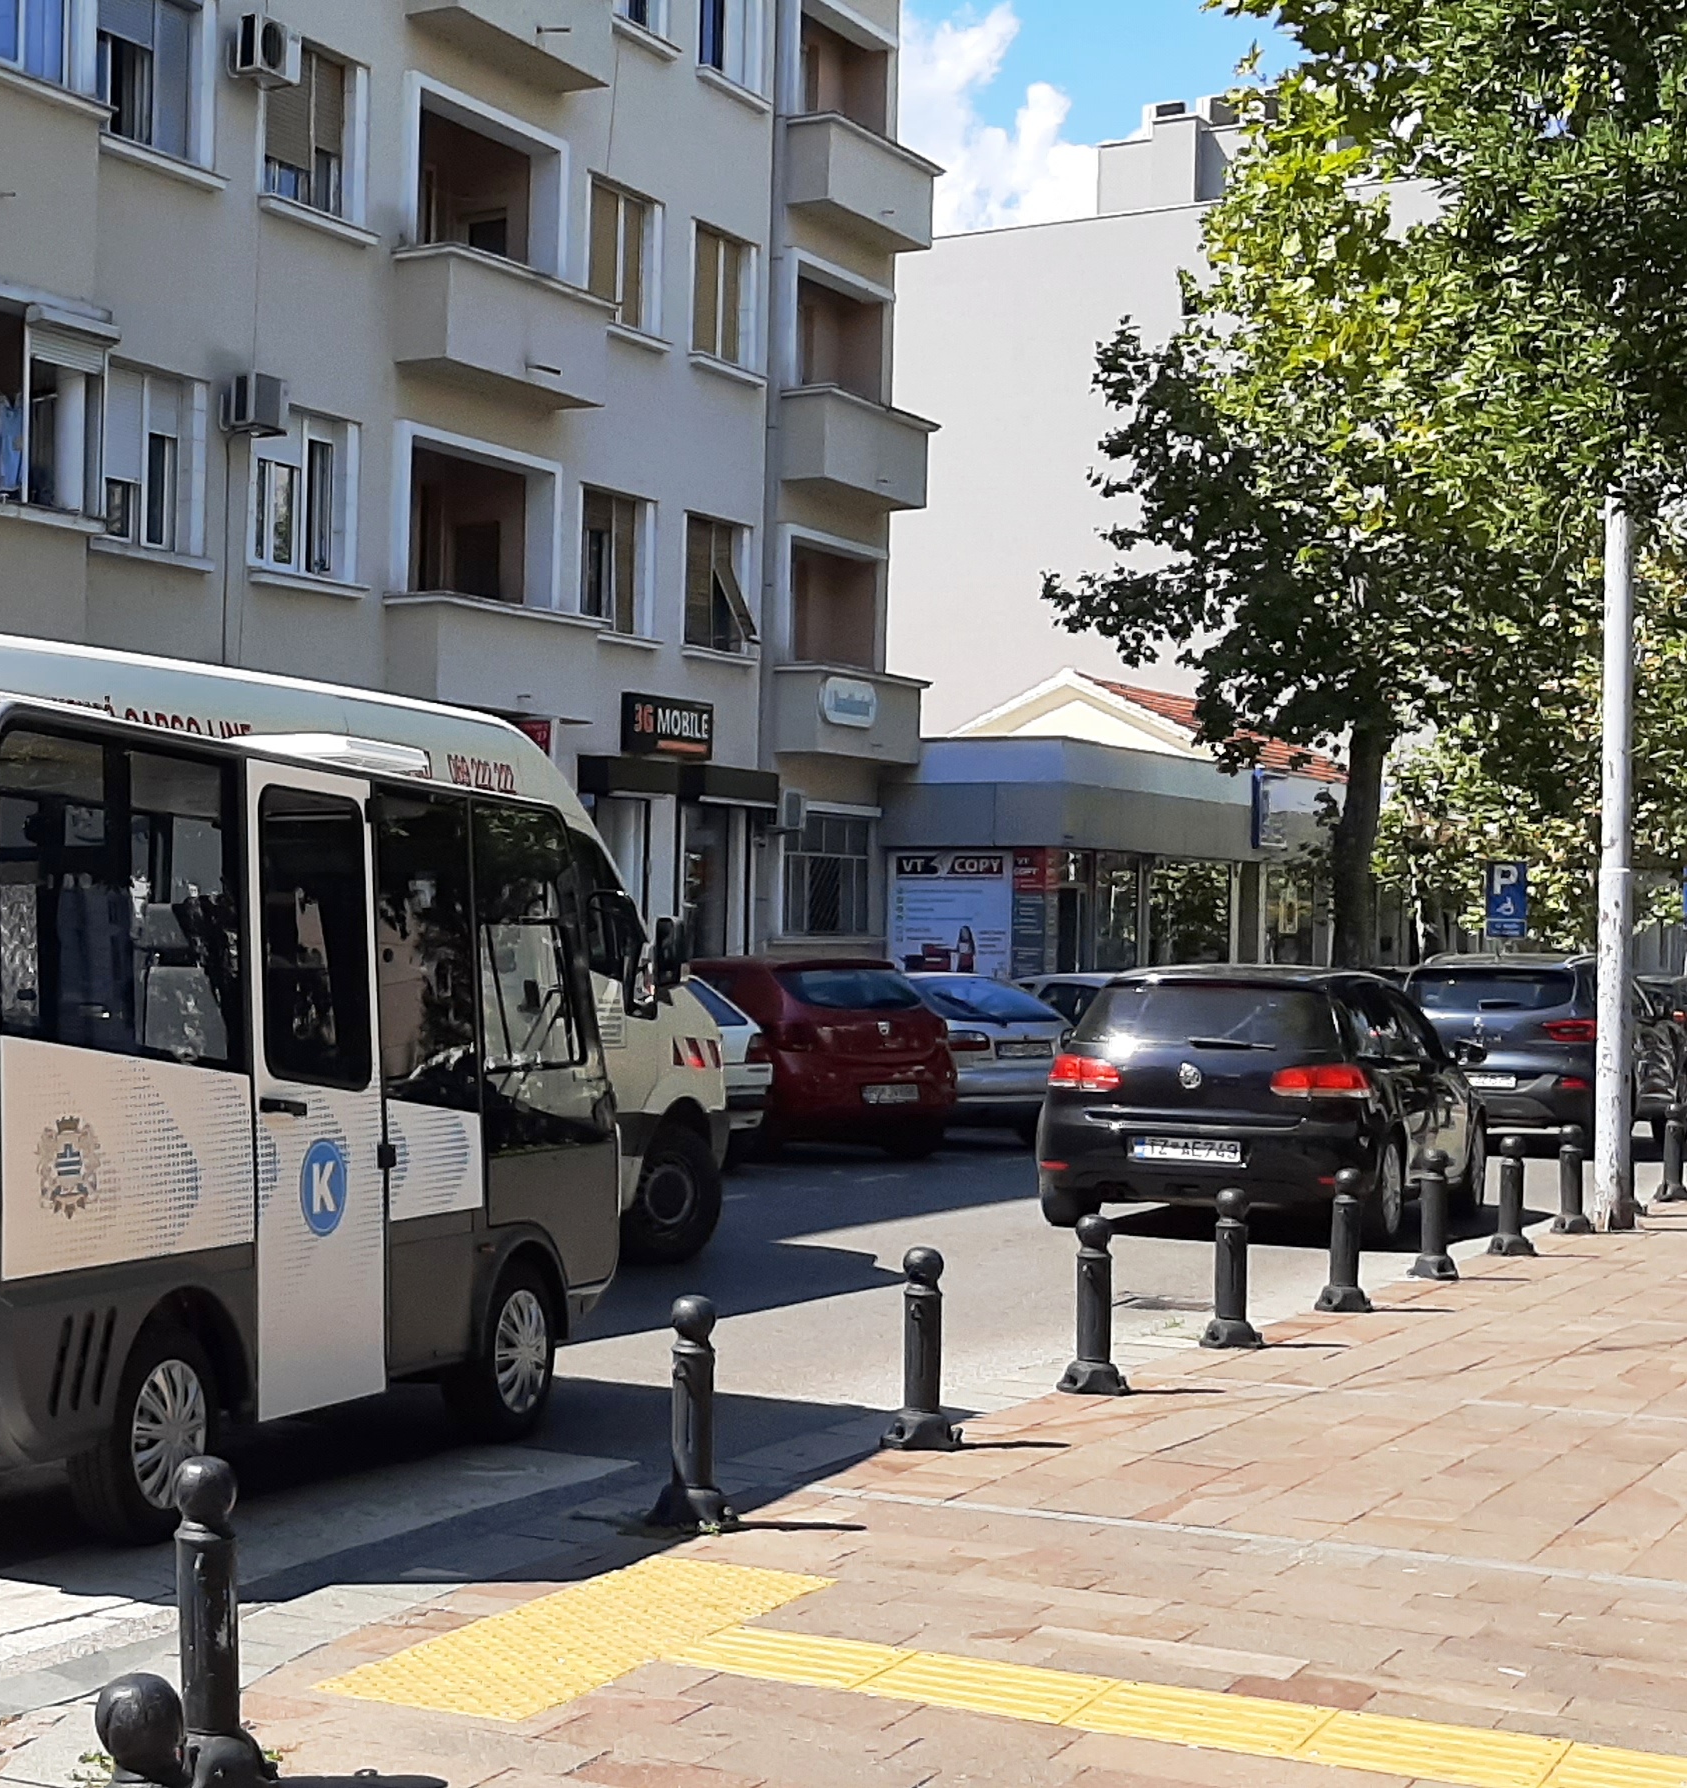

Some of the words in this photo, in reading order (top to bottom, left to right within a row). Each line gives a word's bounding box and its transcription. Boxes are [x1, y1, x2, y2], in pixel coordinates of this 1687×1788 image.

[633, 702, 654, 733] 3G
[657, 707, 709, 739] MOBILE
[903, 859, 925, 872] VT
[954, 858, 1002, 872] COPY
[1493, 864, 1519, 895] P
[312, 1161, 337, 1214] K
